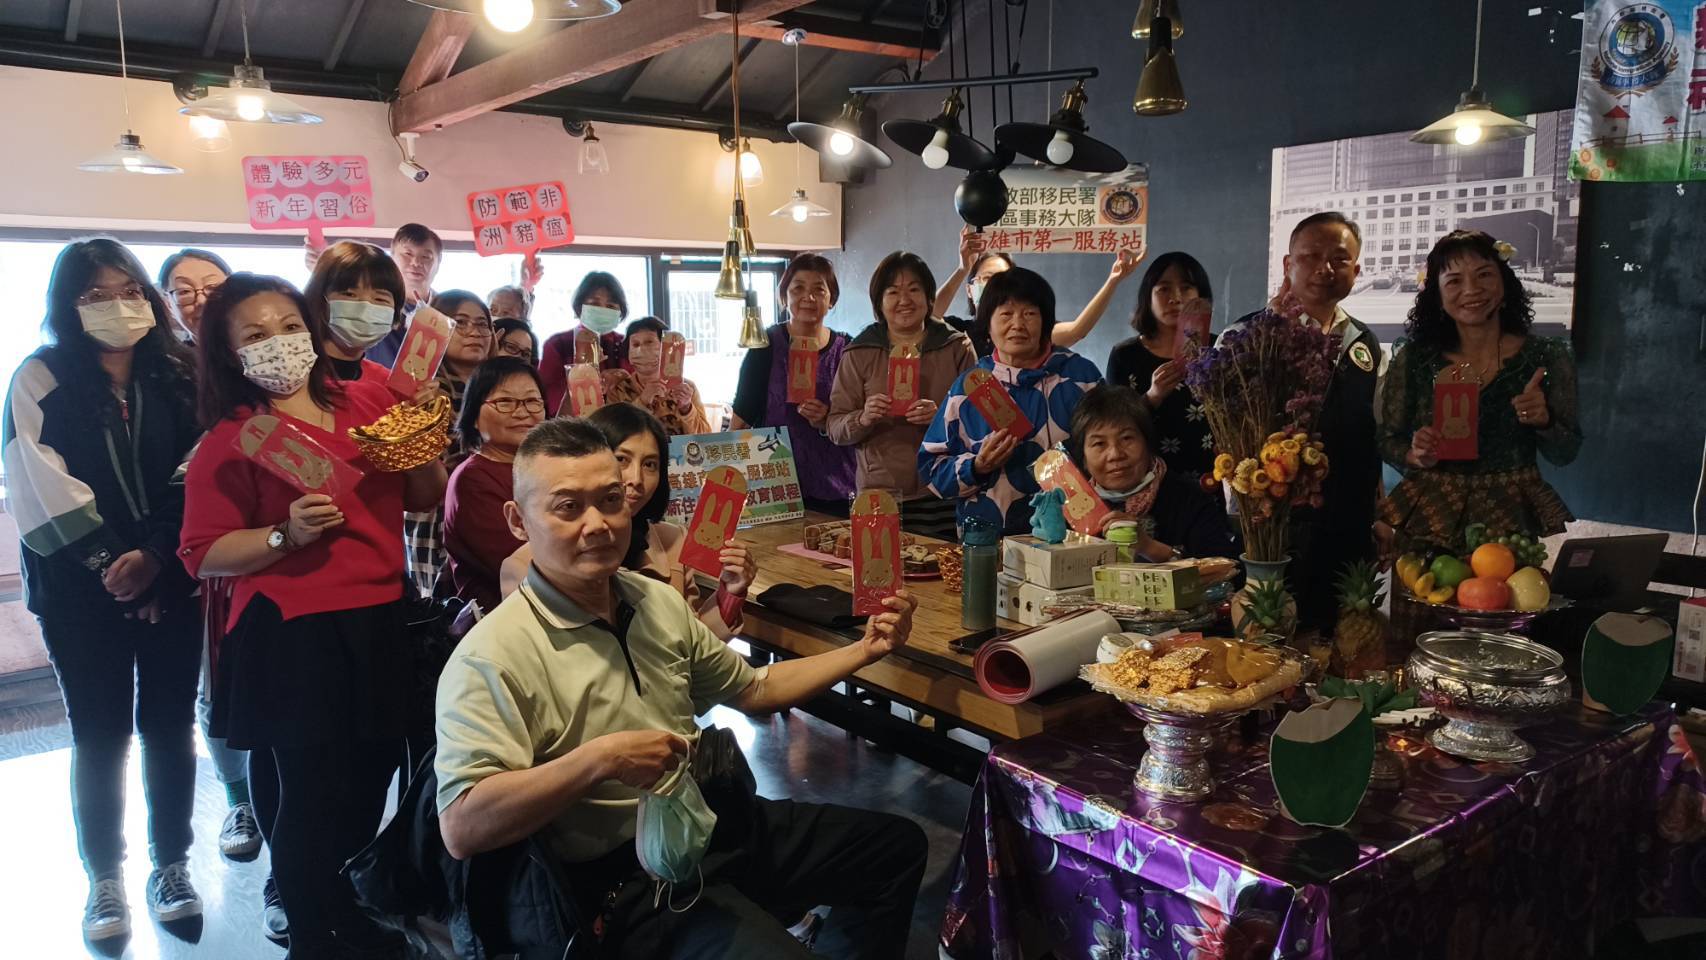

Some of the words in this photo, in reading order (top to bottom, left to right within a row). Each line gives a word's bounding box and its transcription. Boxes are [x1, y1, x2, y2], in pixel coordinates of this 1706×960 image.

[251, 161, 364, 183] 體驗多元
[256, 195, 368, 218] 新年習俗
[478, 188, 557, 218] 防範非
[994, 208, 1096, 227] 區事務大隊
[484, 217, 564, 247] 洲豬瘟
